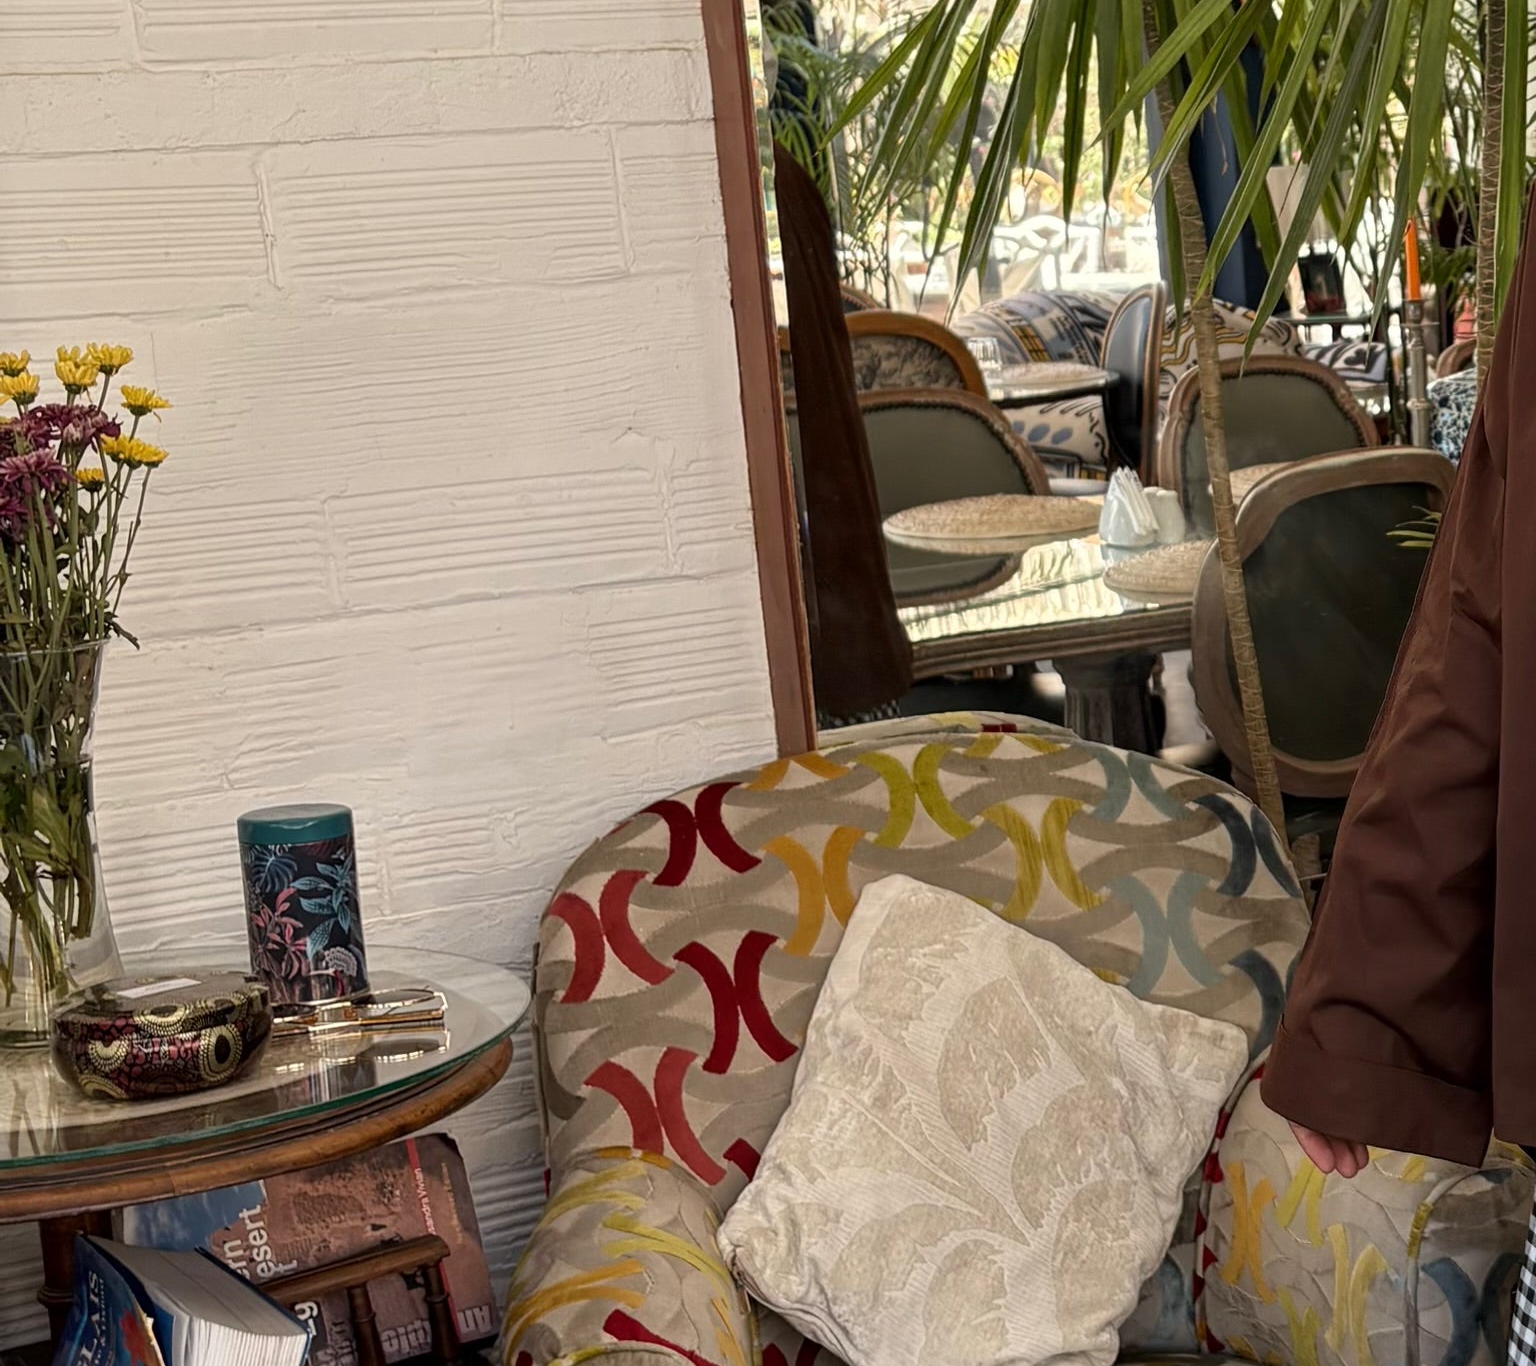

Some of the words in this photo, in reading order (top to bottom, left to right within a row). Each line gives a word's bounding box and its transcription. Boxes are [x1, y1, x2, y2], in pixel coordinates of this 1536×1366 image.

[413, 1168, 427, 1197] Vivian
[420, 1197, 436, 1235] sandra
[238, 1204, 276, 1280] esert
